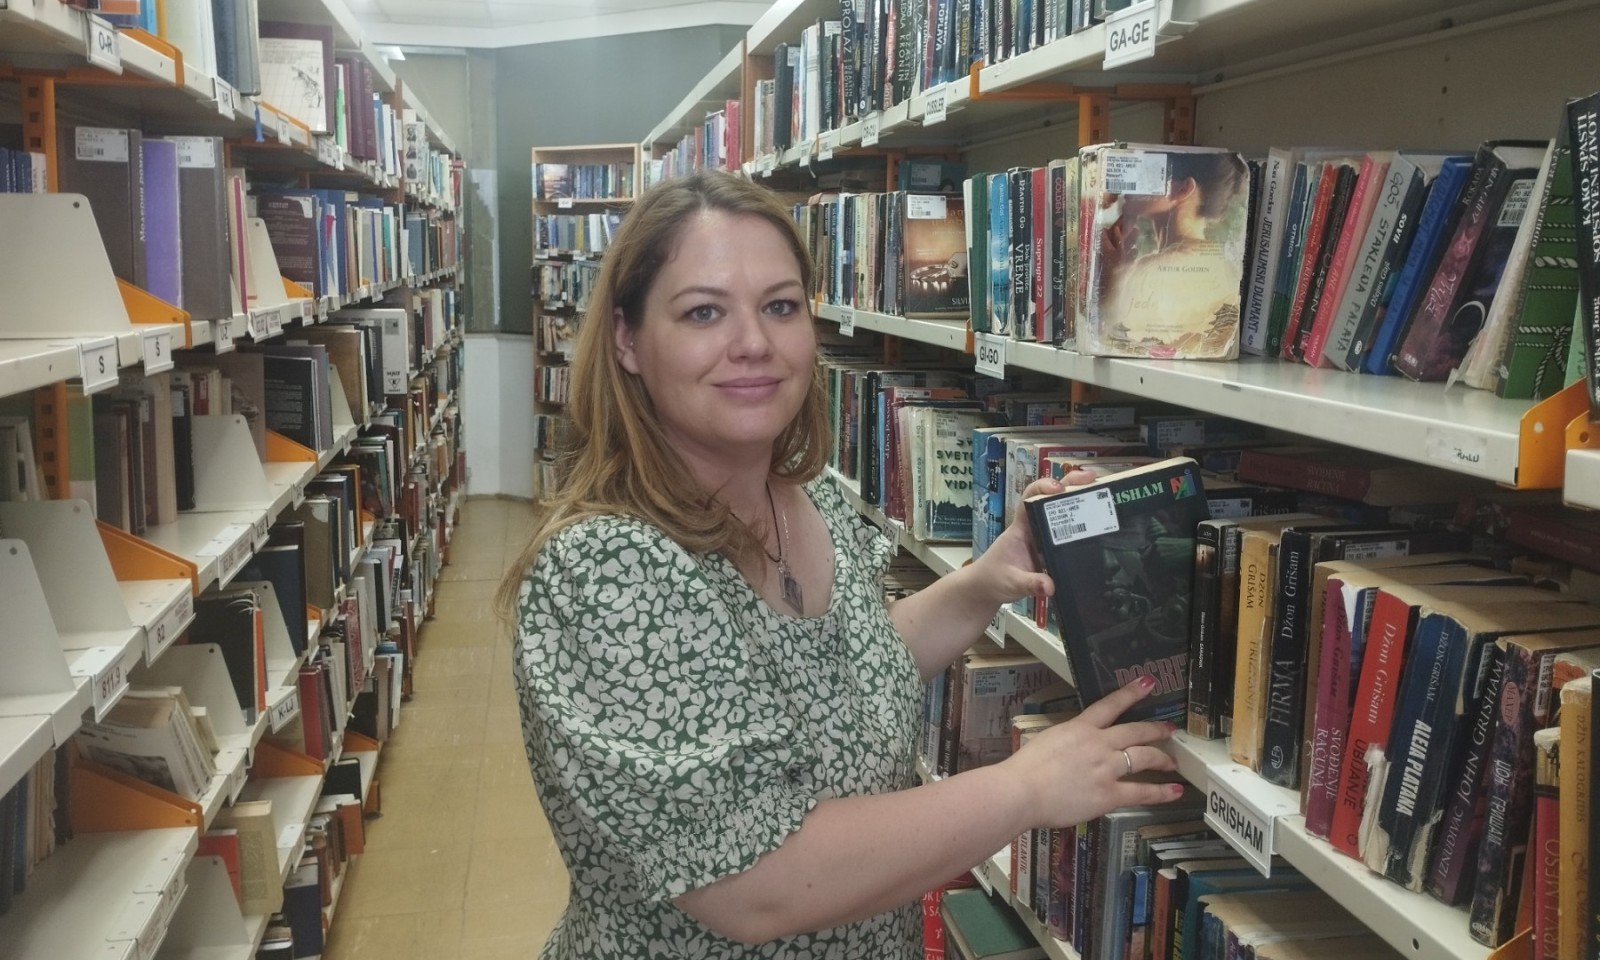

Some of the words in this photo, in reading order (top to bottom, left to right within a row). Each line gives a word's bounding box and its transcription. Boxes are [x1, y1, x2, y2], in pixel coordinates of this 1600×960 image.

[98, 31, 113, 54] O-R
[936, 3, 945, 51] POPLAVA
[1109, 19, 1150, 52] GA-GE
[926, 97, 945, 116] CUSSLER
[1577, 114, 1591, 175] SPASTI
[1586, 111, 1598, 166] ŽIVOT
[1581, 183, 1593, 226] KAKO
[1035, 237, 1043, 282] Supruga
[1256, 217, 1273, 286] JERUSALIMSKI
[1287, 223, 1298, 259] OTMICA
[1015, 243, 1024, 294] VREME
[1036, 285, 1043, 298] 22
[1248, 285, 1263, 333] DIJAMANT
[155, 337, 161, 356] Š
[1337, 302, 1361, 352] PALATA
[99, 355, 105, 374] S
[979, 345, 999, 364] GI-GO
[1112, 481, 1164, 506] ISHAM
[1246, 564, 1258, 609] GRIŠAM
[1285, 551, 1300, 598] Grišam
[156, 624, 166, 643] 82
[1281, 603, 1296, 640] Džon
[1380, 622, 1397, 665] Džon
[102, 667, 121, 699] 811.9
[1269, 659, 1295, 728] FIRMA
[1368, 668, 1389, 725] Grišam
[278, 699, 294, 720] K-LJ
[1408, 719, 1432, 762] ALEJA
[1457, 750, 1480, 806] JOHN
[1472, 659, 1504, 746] GRISHAM
[1312, 727, 1329, 789] RAČUNA
[1345, 738, 1366, 808] UBIJANJE
[1395, 757, 1423, 817] PLATANA
[1575, 754, 1588, 824] KALOGRIDIS
[1210, 790, 1264, 854] GRISHAM
[1487, 799, 1506, 846] ГРИШАМ
